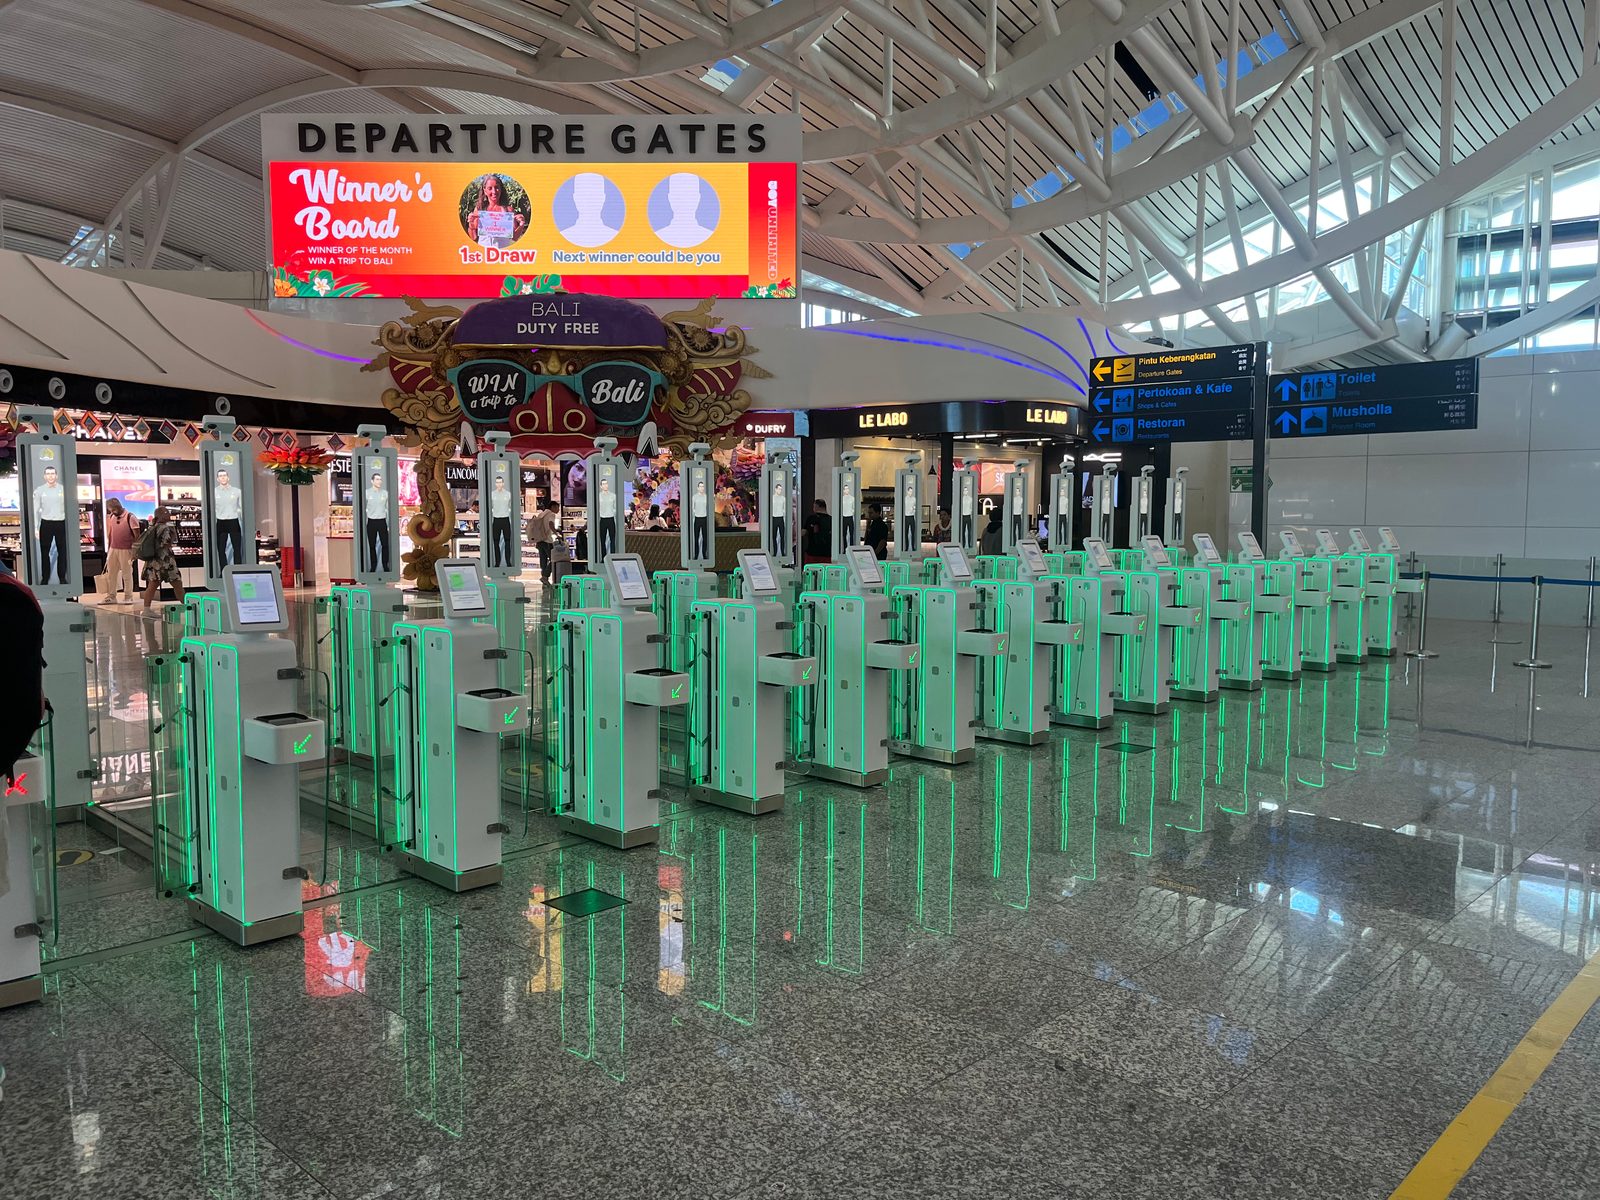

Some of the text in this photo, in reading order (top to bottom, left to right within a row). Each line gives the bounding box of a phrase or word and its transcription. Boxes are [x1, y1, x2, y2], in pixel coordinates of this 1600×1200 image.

[298, 123, 766, 154] DEPARTURE GATES
[289, 169, 433, 204] Winner's
[295, 206, 400, 241] Board
[373, 257, 393, 265] BALI
[460, 246, 535, 263] 1st Draw
[553, 250, 721, 265] Next winner could be you
[531, 302, 581, 317] BALI
[517, 322, 600, 335] DUTY FREE
[1138, 351, 1217, 366] Pintu Keberangkatan
[1138, 370, 1165, 379] Departure
[1339, 371, 1377, 385] Toilet
[468, 372, 519, 394] WIN
[591, 379, 645, 405] Bali
[1138, 383, 1233, 399] Pertokoan & Kafe
[470, 394, 518, 410] a trip to
[1137, 403, 1154, 411] Shops
[1026, 408, 1067, 424] LE LABO
[1332, 404, 1393, 418] Musholla
[859, 411, 908, 428] LE LABO
[1137, 418, 1185, 429] Restoran
[755, 424, 786, 433] DUFRY
